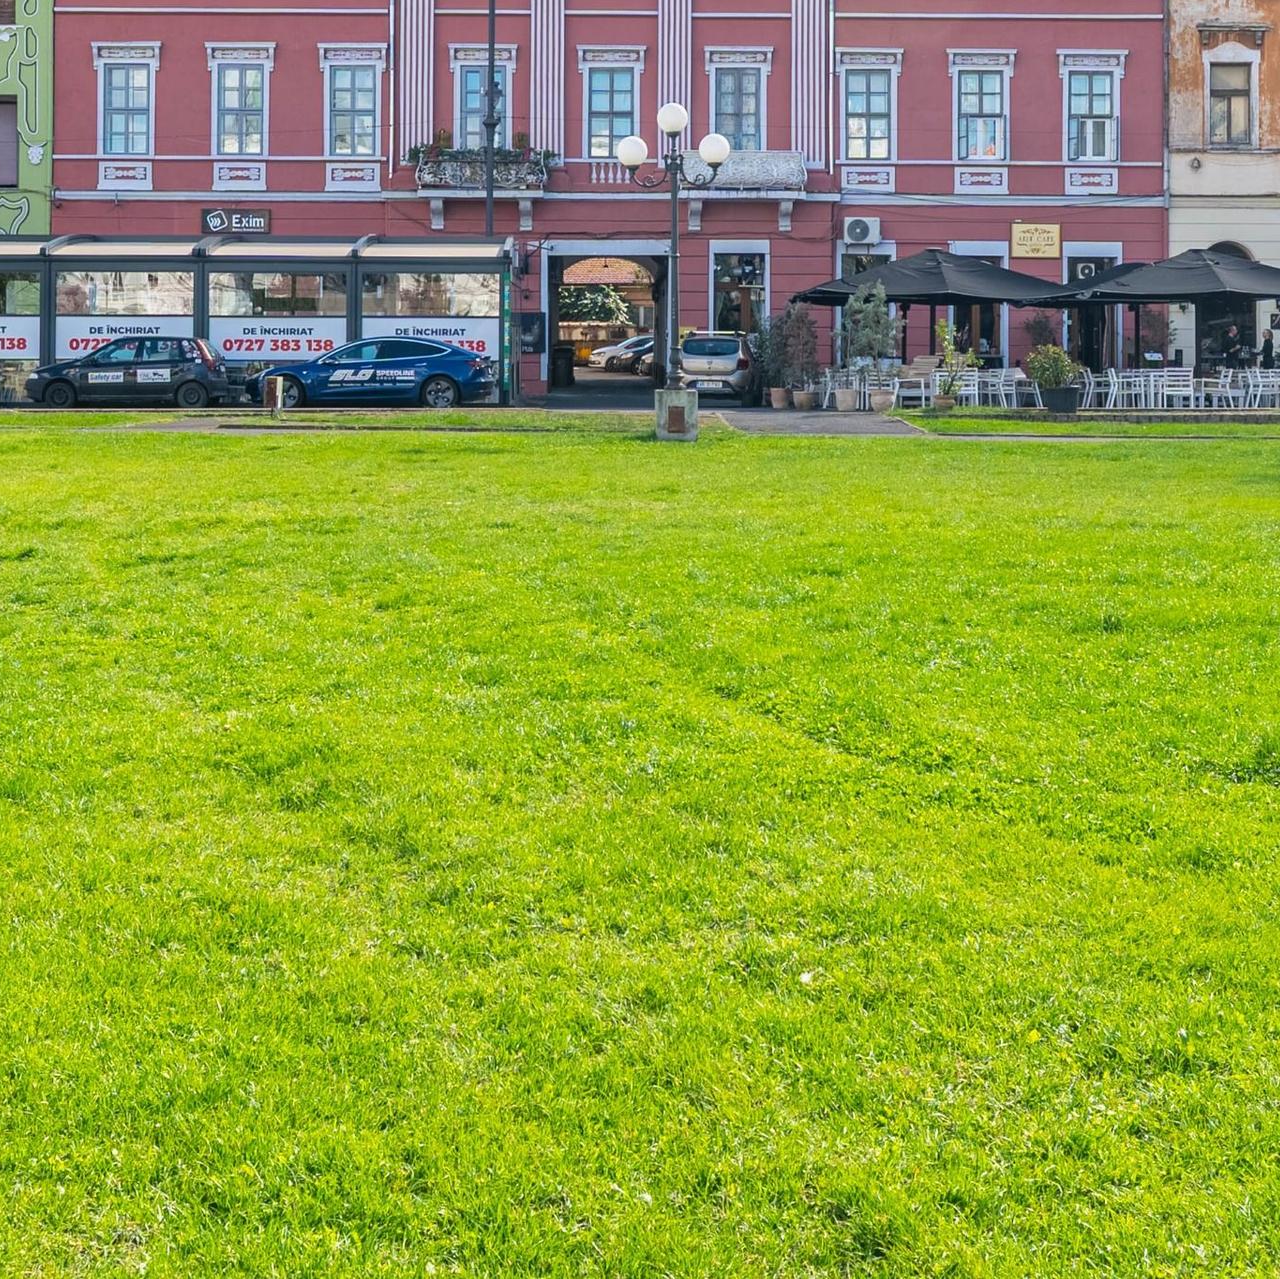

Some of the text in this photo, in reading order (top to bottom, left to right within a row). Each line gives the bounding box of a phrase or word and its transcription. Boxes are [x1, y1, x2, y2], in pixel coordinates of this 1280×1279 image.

[232, 215, 264, 227] Exim
[89, 325, 161, 335] DE ÎNCHIRIAT
[243, 326, 314, 336] DE ÎNCHIRIAT
[395, 326, 466, 336] DE ÎNCHIRIAT
[0, 338, 27, 350] 138
[223, 339, 334, 351] 0727 383 138
